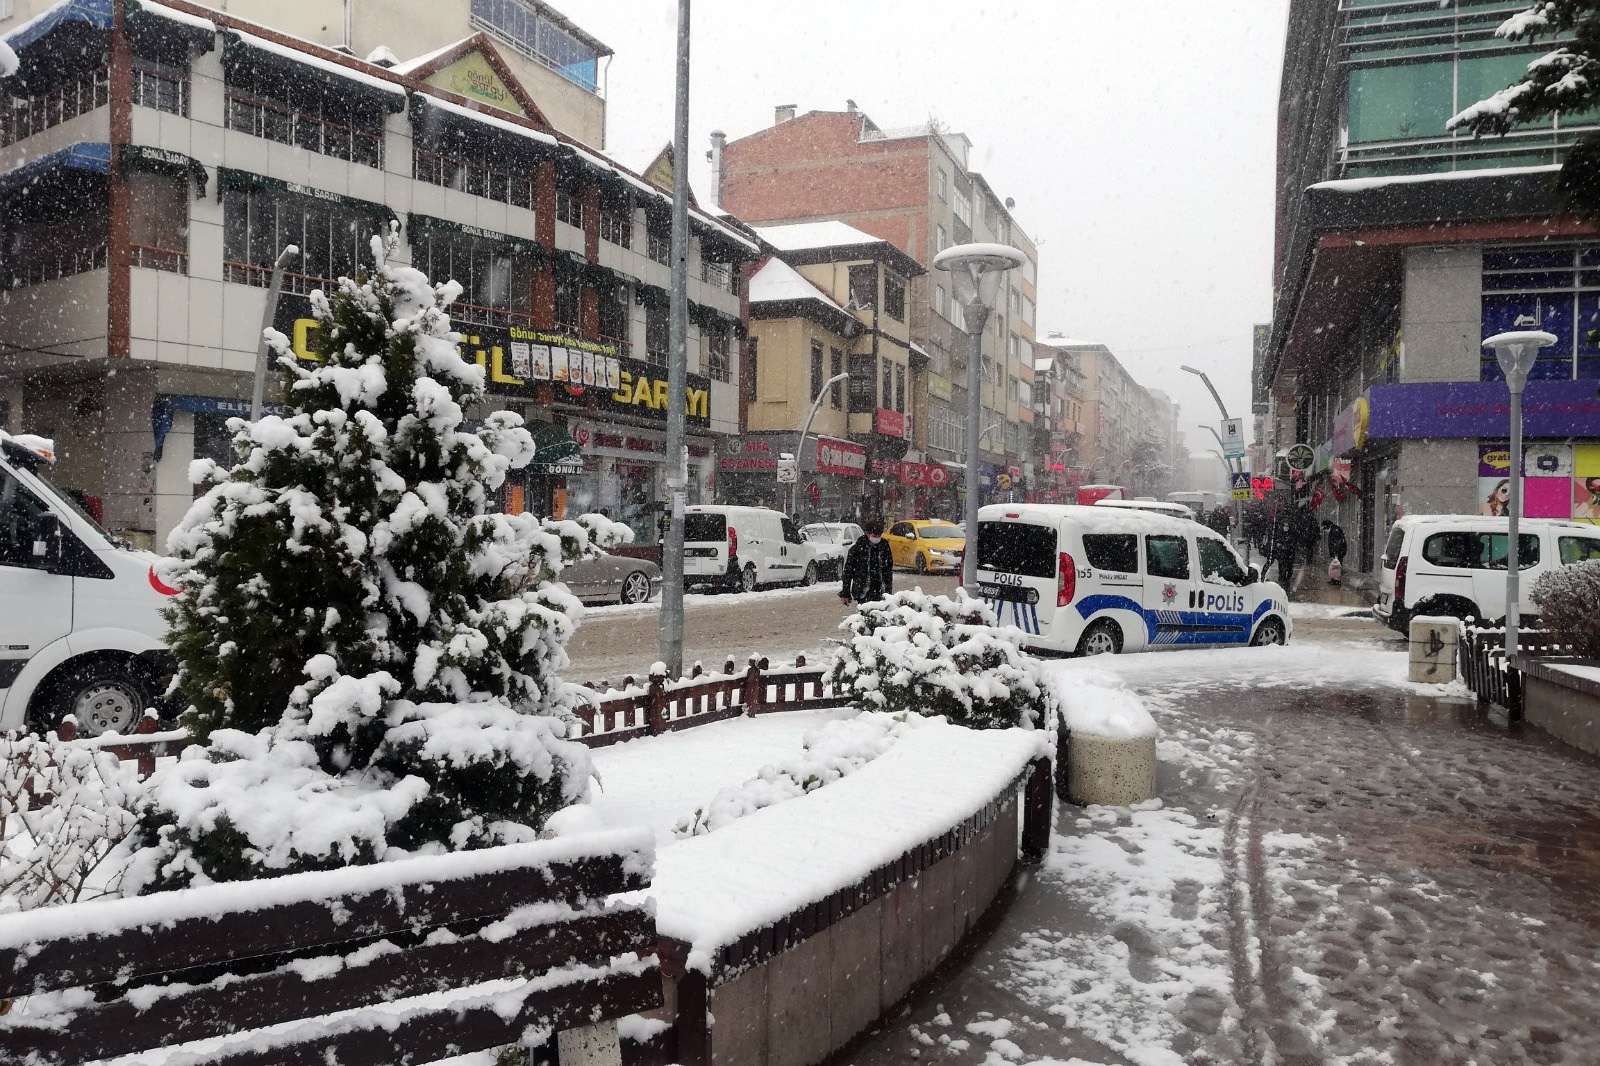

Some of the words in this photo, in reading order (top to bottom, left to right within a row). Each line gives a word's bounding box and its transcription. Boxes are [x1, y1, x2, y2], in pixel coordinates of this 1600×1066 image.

[1486, 454, 1511, 463] grati
[993, 573, 1023, 586] POLİS
[1077, 568, 1092, 579] 155
[1207, 590, 1244, 612] POLİS
